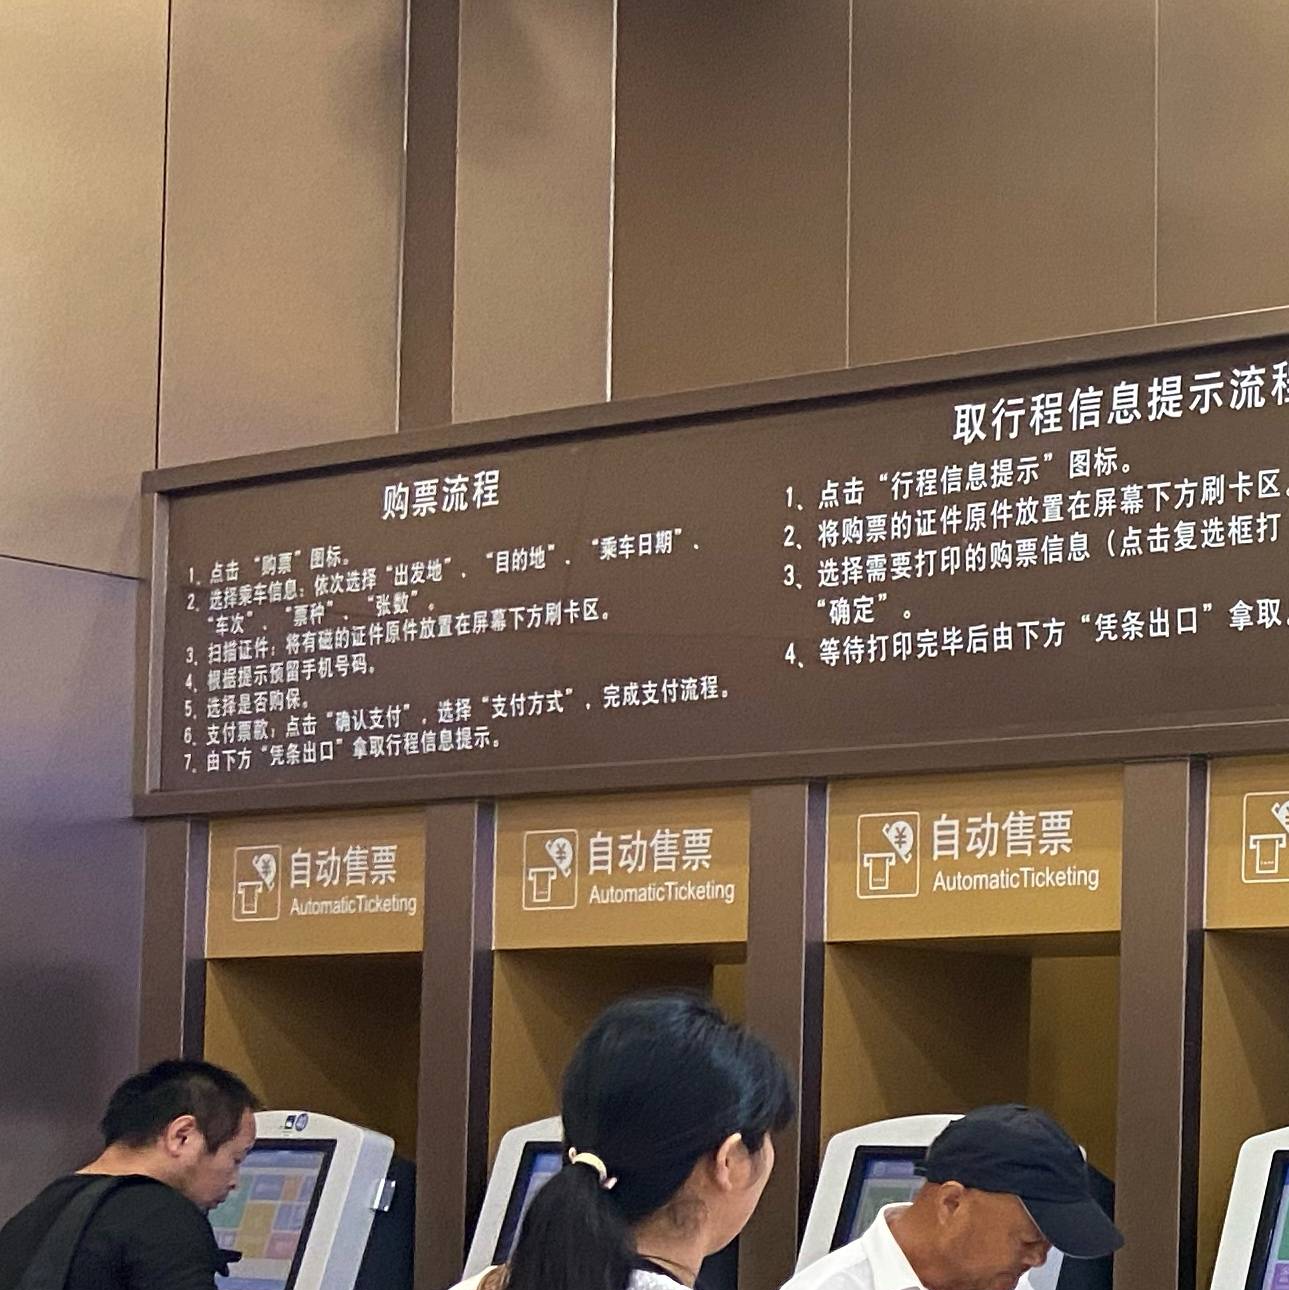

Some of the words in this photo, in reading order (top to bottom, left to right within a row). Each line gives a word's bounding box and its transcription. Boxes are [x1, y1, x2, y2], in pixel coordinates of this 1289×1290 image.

[381, 469, 501, 521] 购票流程
[589, 827, 714, 877] 自动售票
[931, 809, 1074, 860] 自动售票
[289, 844, 398, 891] 自动售票
[932, 865, 1100, 892] AutomaticTicketing
[289, 894, 417, 917] AutomaticTicketing
[589, 880, 736, 906] AutomaticTicketing
